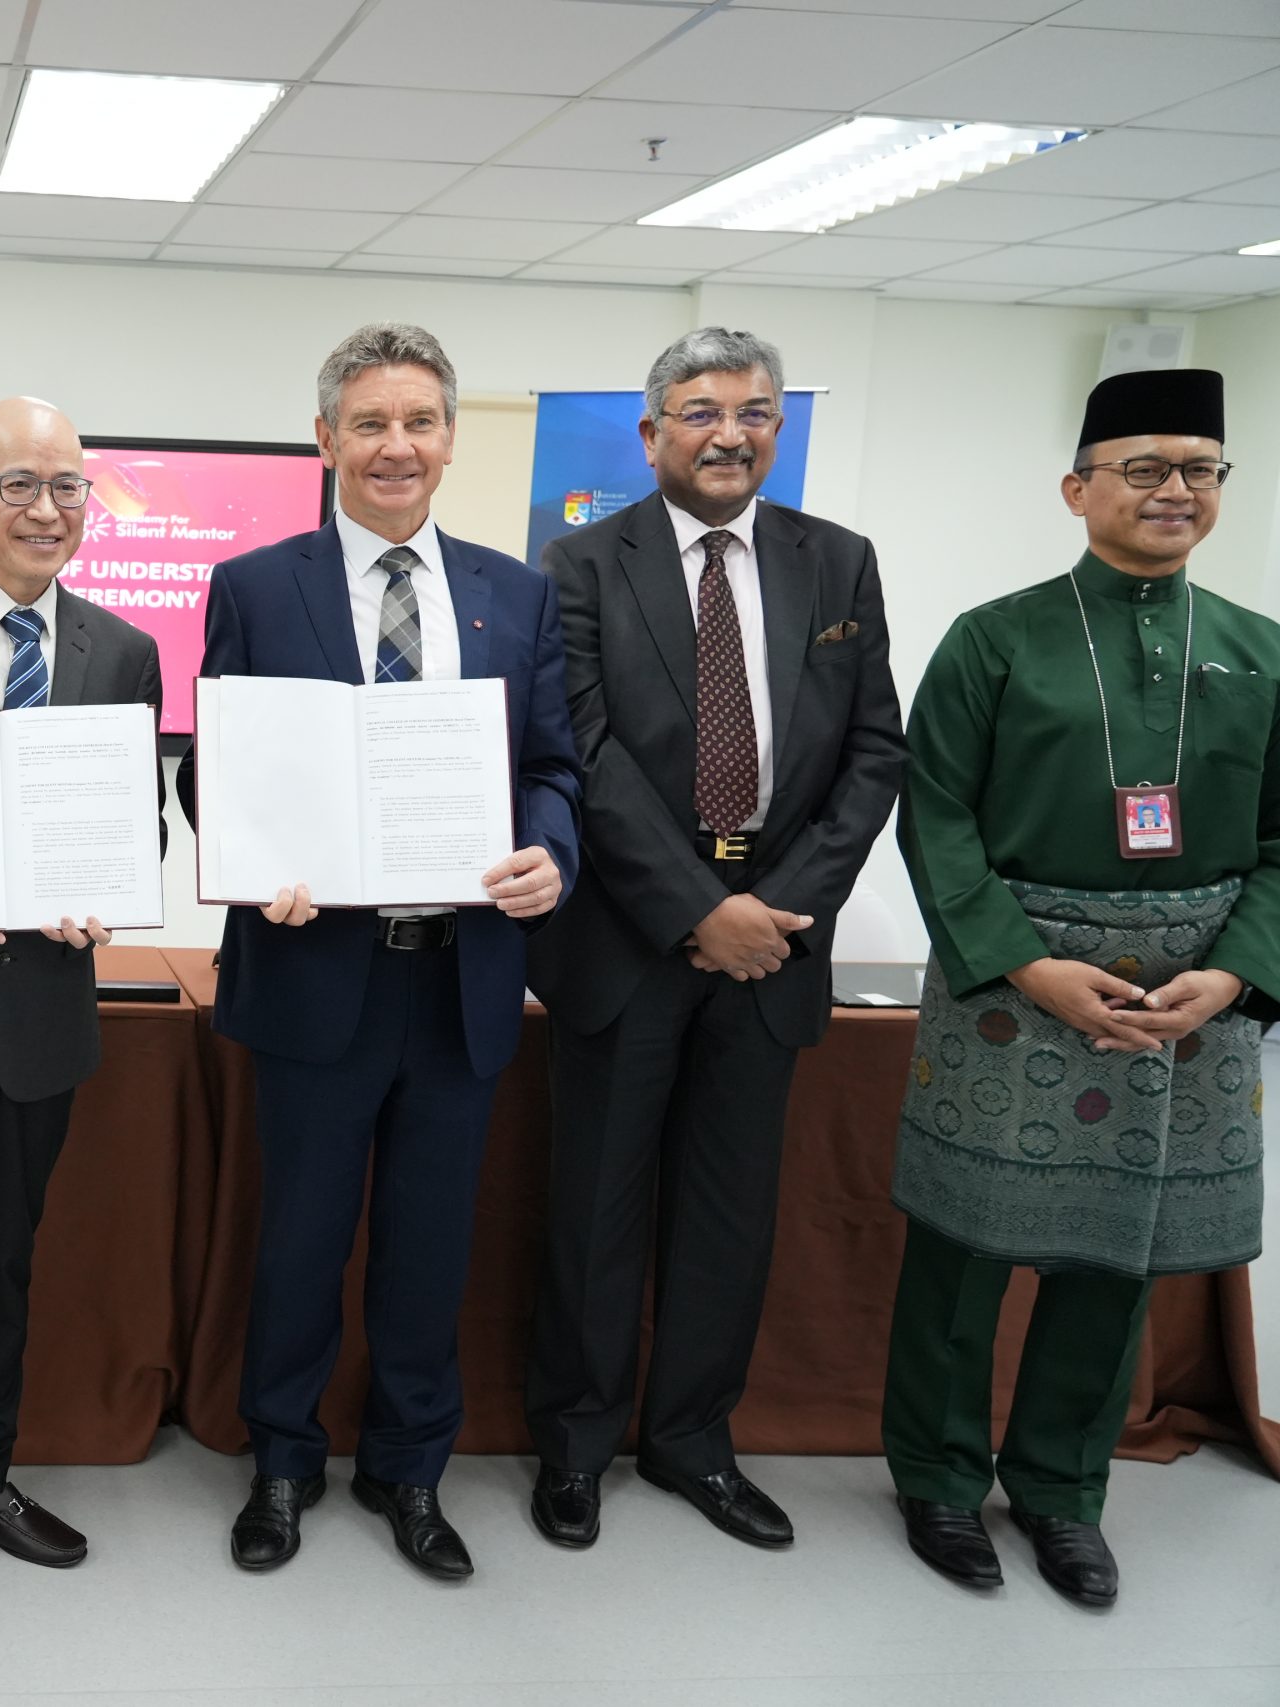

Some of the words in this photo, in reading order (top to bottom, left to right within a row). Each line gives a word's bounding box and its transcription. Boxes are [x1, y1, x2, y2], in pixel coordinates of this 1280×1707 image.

[170, 514, 190, 524] For
[115, 522, 166, 538] Silent
[170, 525, 236, 540] Mentor
[64, 584, 201, 608] EREMONY
